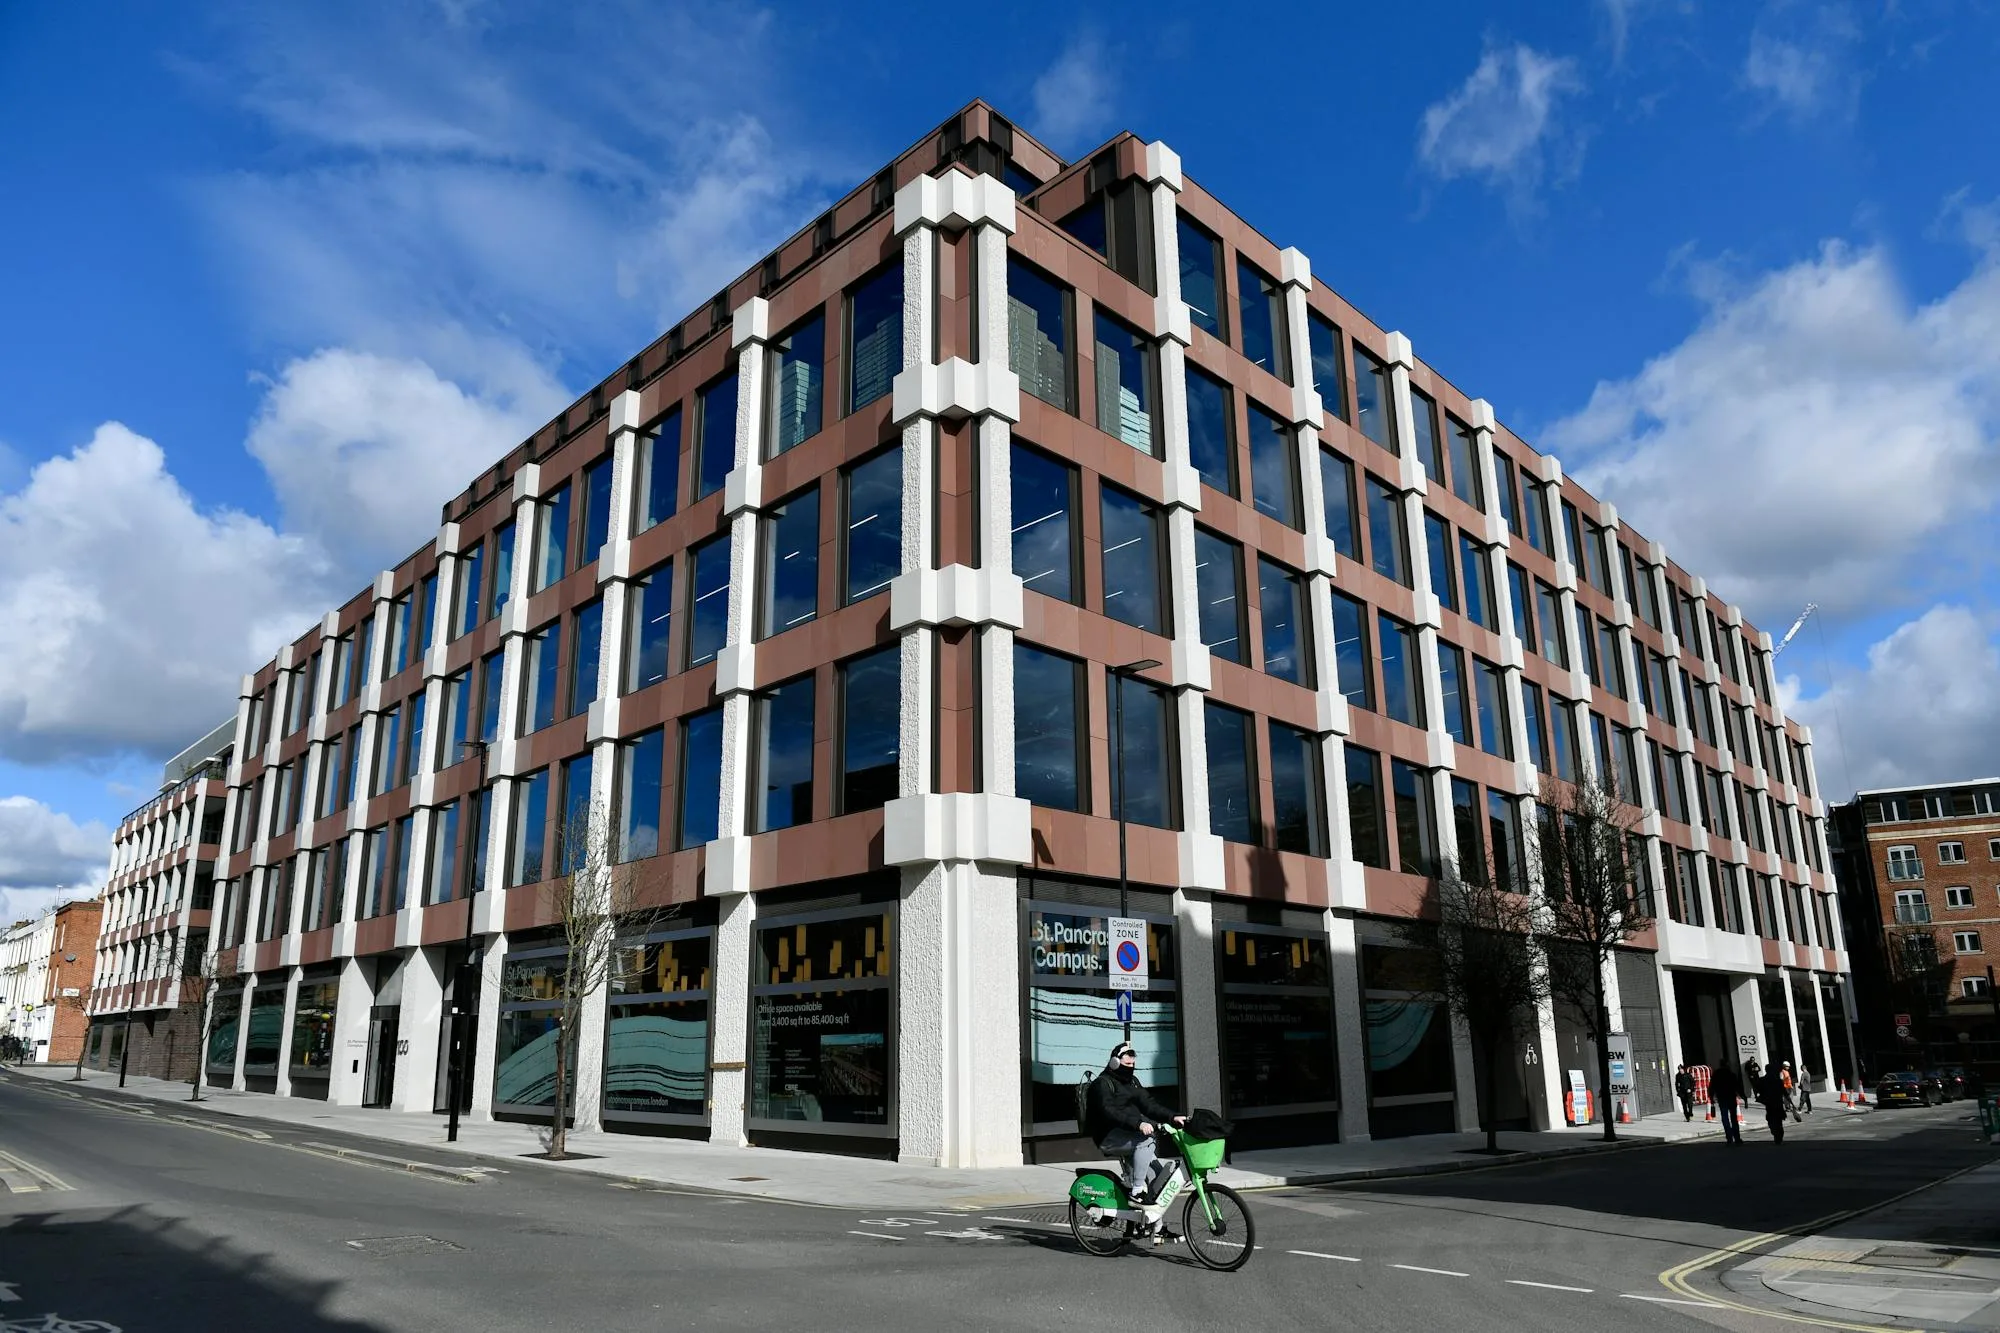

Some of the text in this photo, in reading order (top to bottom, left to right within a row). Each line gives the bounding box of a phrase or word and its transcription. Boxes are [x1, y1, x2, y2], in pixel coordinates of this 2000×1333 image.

[1112, 920, 1143, 929] Controlled
[1036, 920, 1109, 945] St.Pancra
[1116, 930, 1140, 939] ZONE
[1034, 945, 1103, 974] Campus.
[758, 1001, 823, 1015] Office space available
[811, 1014, 834, 1025] 85,400
[1739, 1035, 1757, 1046] 63
